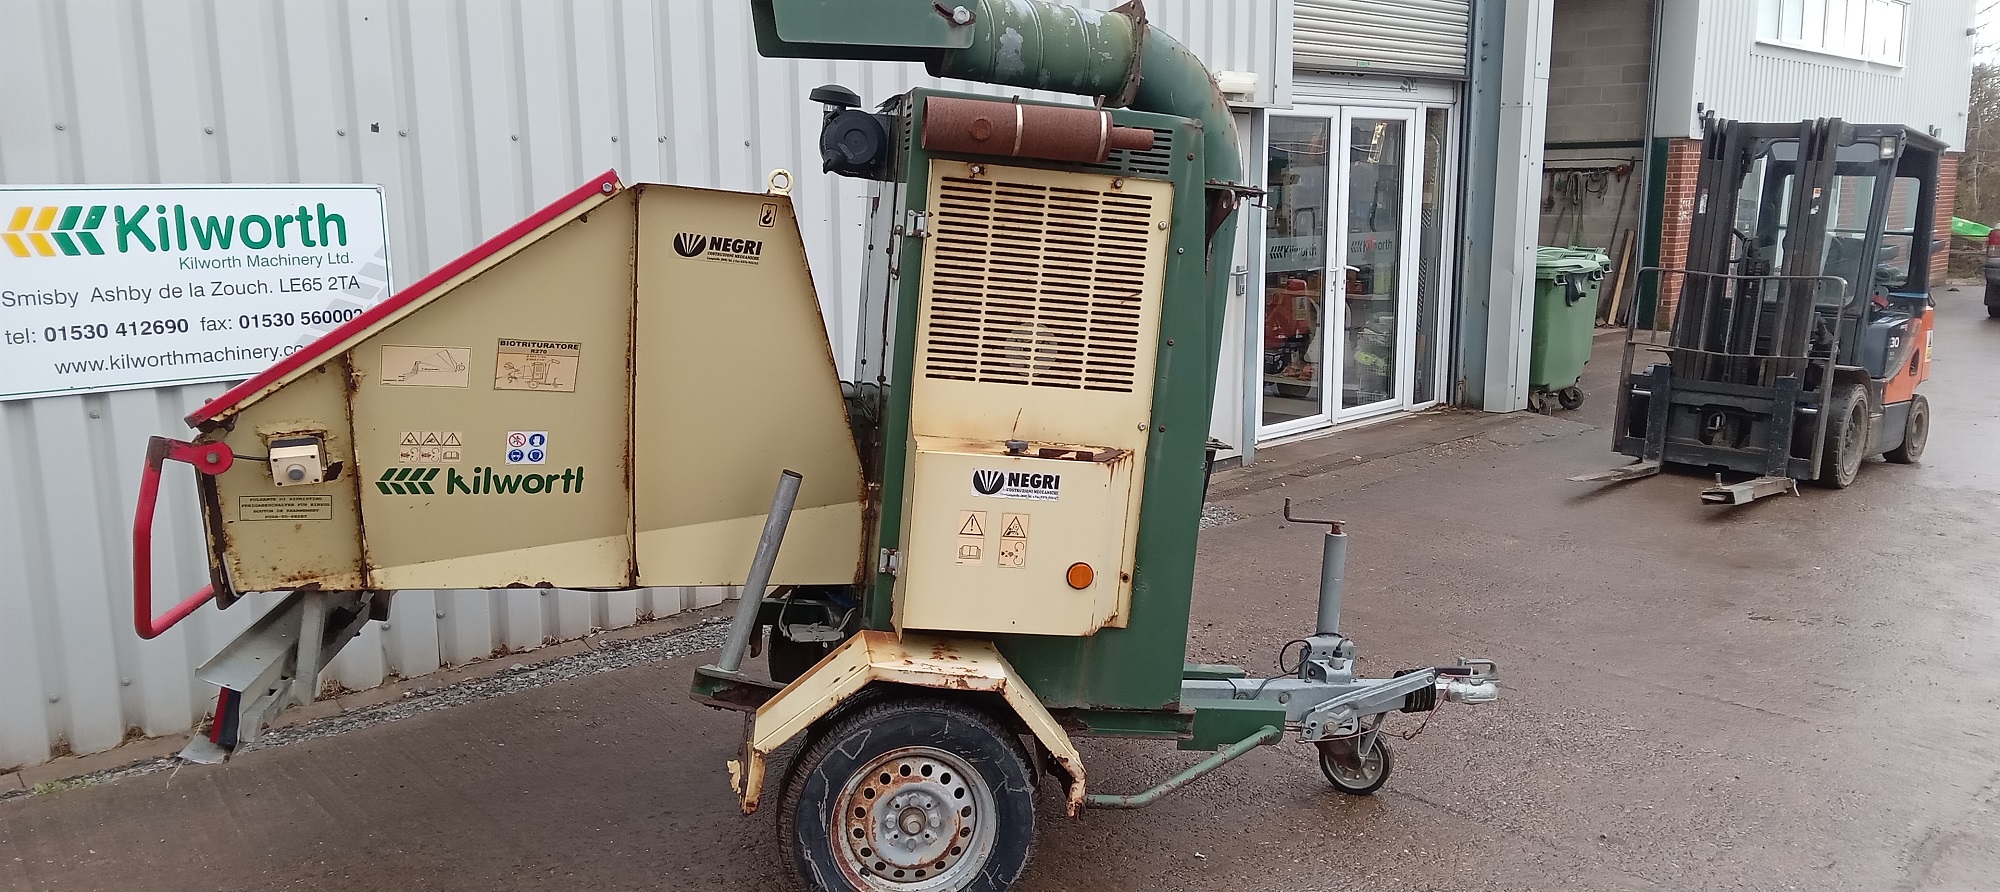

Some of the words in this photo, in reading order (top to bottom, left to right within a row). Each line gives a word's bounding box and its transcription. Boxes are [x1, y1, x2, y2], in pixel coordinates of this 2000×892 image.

[113, 202, 348, 253] Kilworth
[709, 237, 763, 255] NEGRI
[178, 255, 242, 270] Kilworth
[246, 253, 323, 268] Machinery
[327, 252, 354, 265] Ltd.
[1, 289, 79, 308] Smisby
[90, 285, 152, 304] Ashby
[158, 283, 183, 299] de
[188, 282, 206, 298] la
[210, 280, 273, 297] Zouch.
[279, 277, 323, 293] LE65
[328, 275, 361, 291] 2TA
[4, 327, 37, 345] tel:
[43, 323, 109, 342] 01530
[115, 318, 189, 337] 412690
[200, 316, 232, 332] fax:
[238, 312, 295, 329] 01530
[500, 340, 579, 350] BIOTRITURATORE
[1008, 473, 1060, 490] NEGRI
